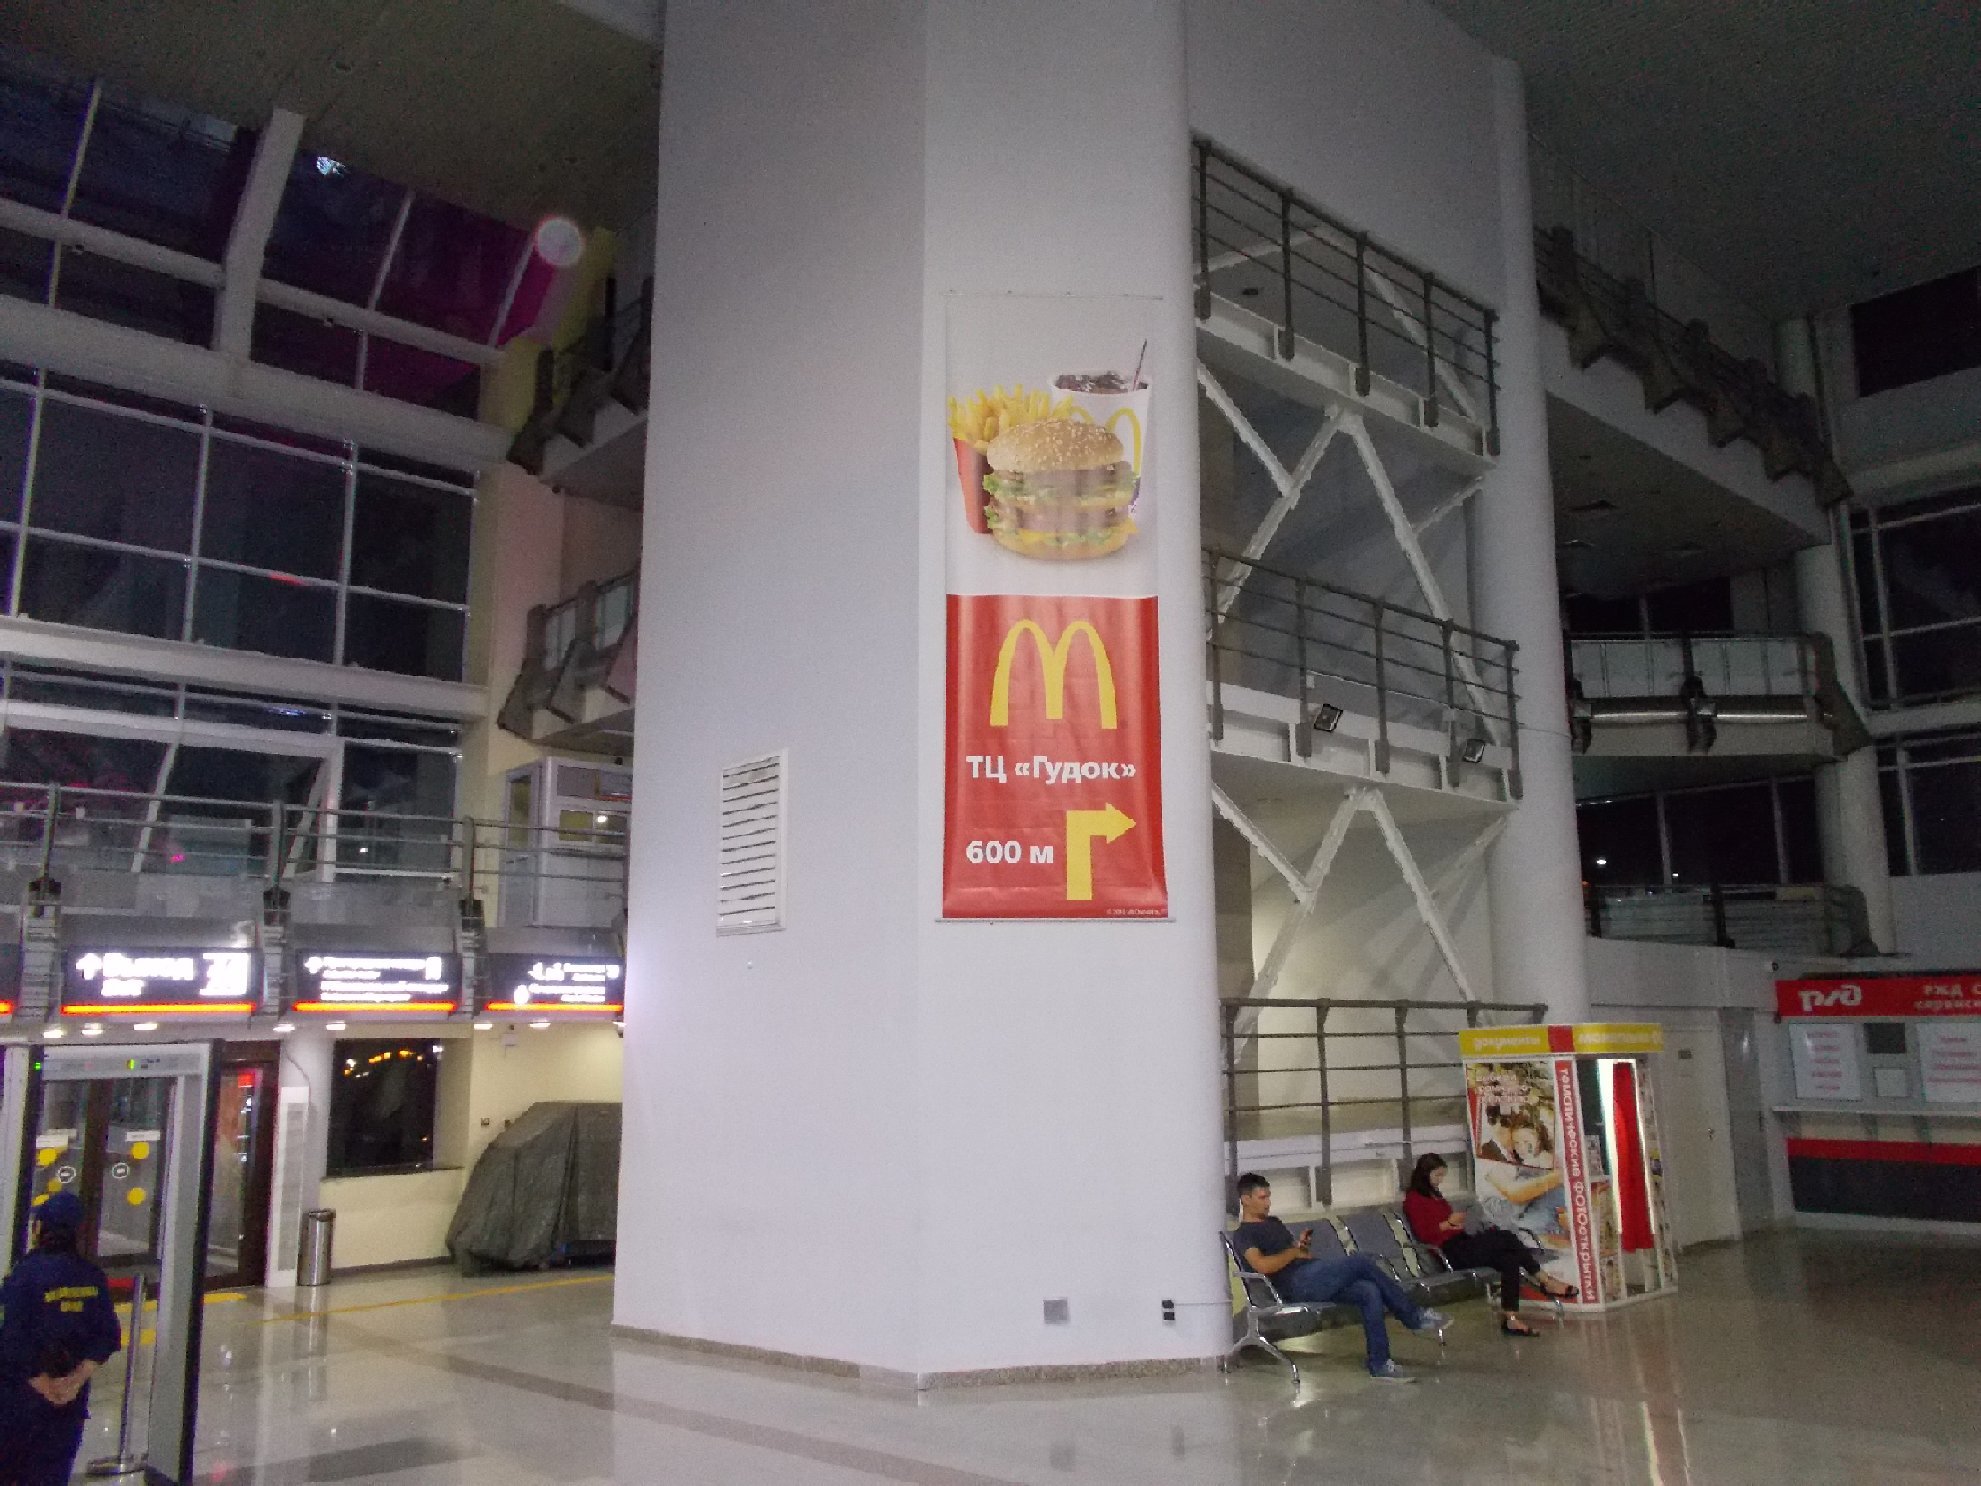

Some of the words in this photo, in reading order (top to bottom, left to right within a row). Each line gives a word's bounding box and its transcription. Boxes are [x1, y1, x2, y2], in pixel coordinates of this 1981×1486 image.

[965, 755, 1007, 784] ТЦ
[1014, 755, 1137, 785] «Гудок»
[965, 840, 1022, 864] 600
[1029, 845, 1055, 864] м
